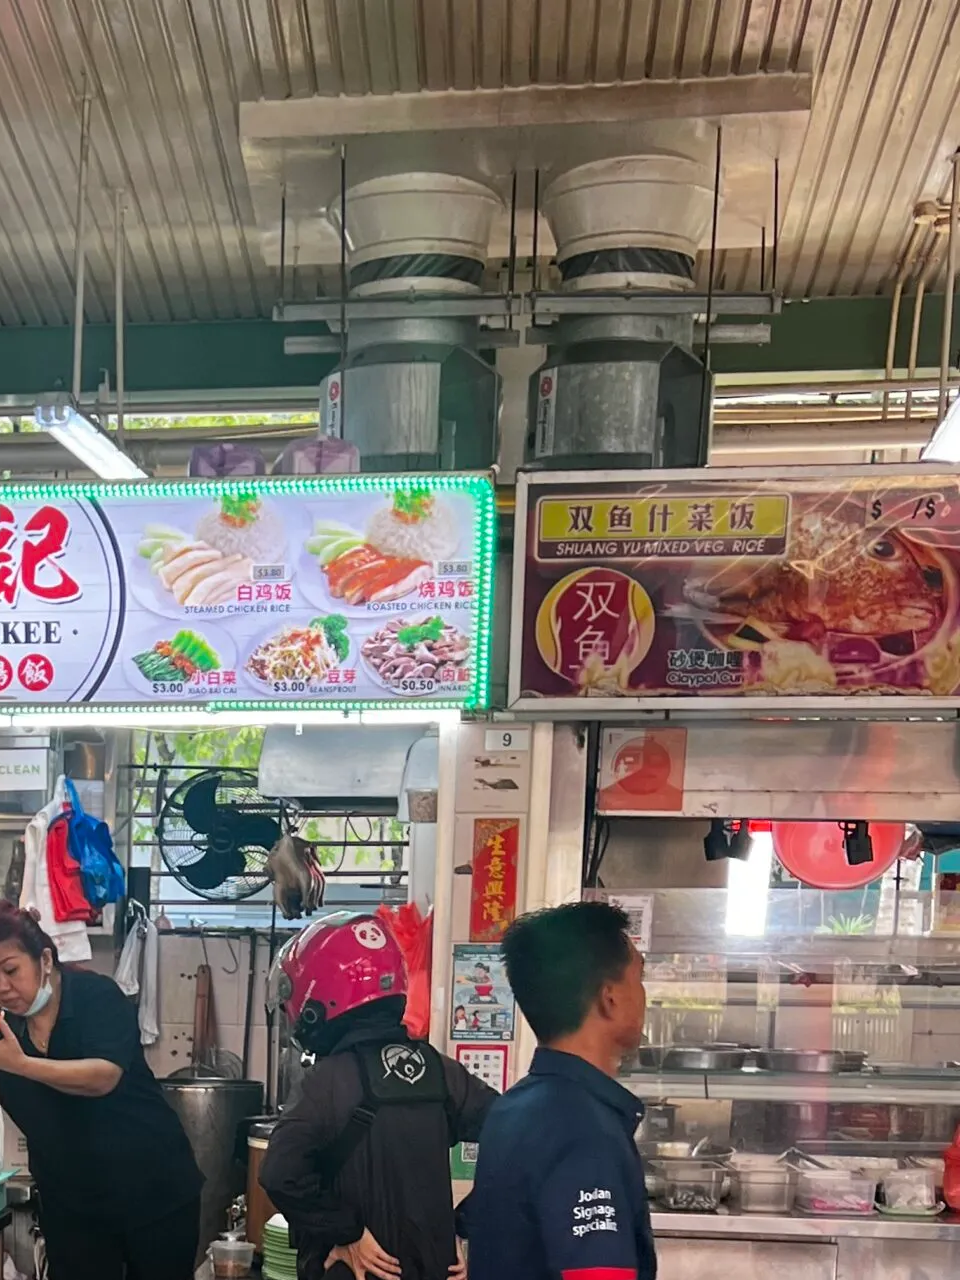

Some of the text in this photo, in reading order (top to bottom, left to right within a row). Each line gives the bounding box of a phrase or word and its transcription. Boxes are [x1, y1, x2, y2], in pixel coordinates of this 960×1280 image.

[871, 499, 883, 520] $
[568, 503, 755, 533] 双鱼什菜饭
[556, 539, 765, 556] SHUANG YU MIXED VEG. RICE
[237, 583, 292, 601] 白鸡饭
[184, 604, 291, 614] STEAMED CHICKEN RICE
[366, 602, 407, 611] ROASTED
[409, 601, 452, 611] CHICKEN
[0, 620, 62, 645] KEE
[190, 670, 237, 685] 小白菜
[326, 669, 357, 684] 豆芽
[666, 671, 717, 687] Claypot
[152, 683, 184, 694] $3.00
[273, 681, 305, 692] $3.00
[401, 680, 434, 691] $0.50
[502, 732, 513, 747] 9
[573, 1204, 616, 1220] Signage
